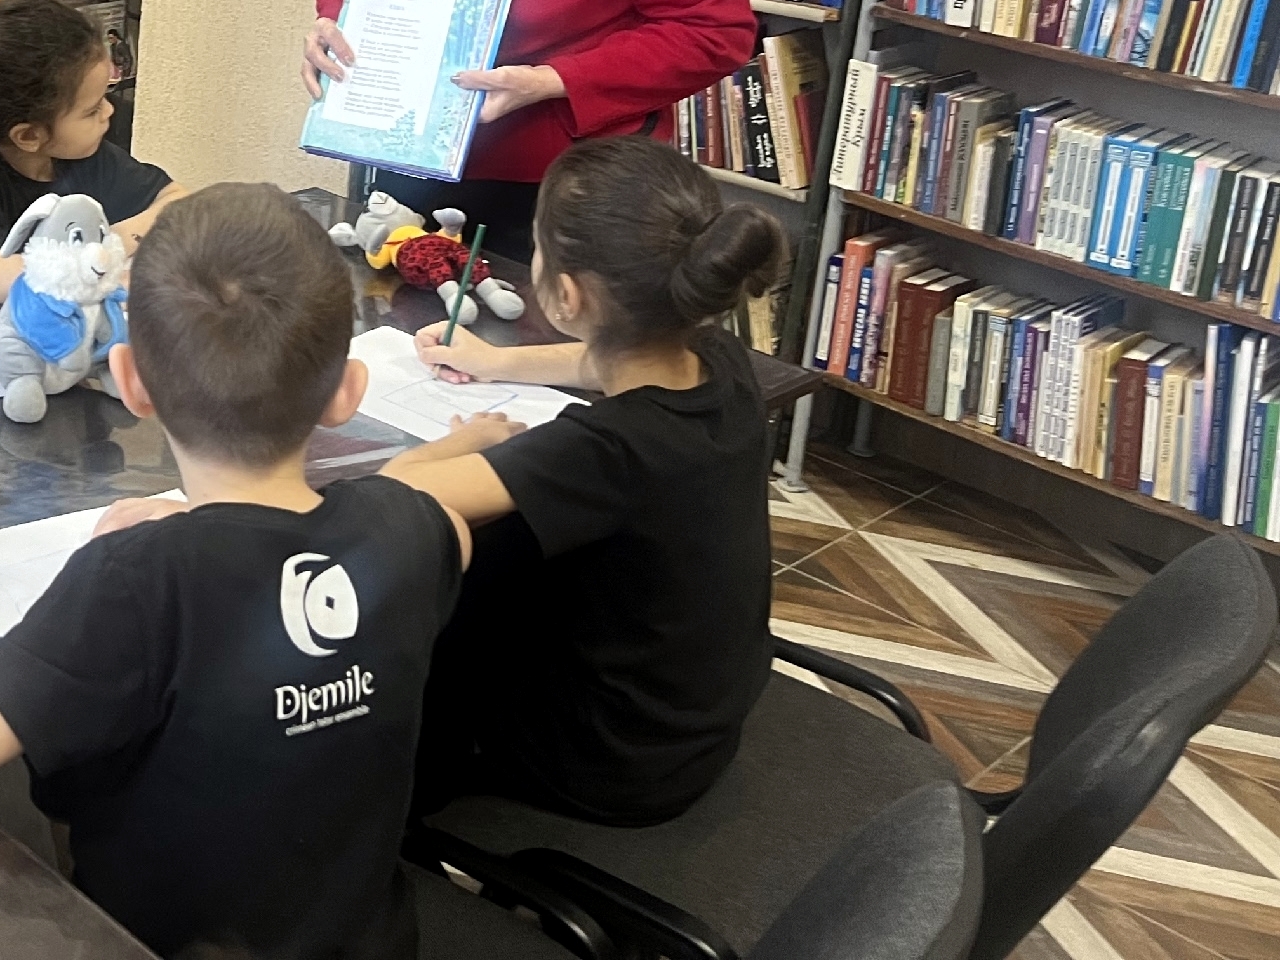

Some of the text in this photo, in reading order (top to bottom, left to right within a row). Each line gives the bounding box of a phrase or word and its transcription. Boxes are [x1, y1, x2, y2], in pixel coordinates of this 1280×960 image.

[832, 68, 859, 180] Литературный
[850, 108, 867, 147] Крым
[274, 664, 375, 723] Djemile
